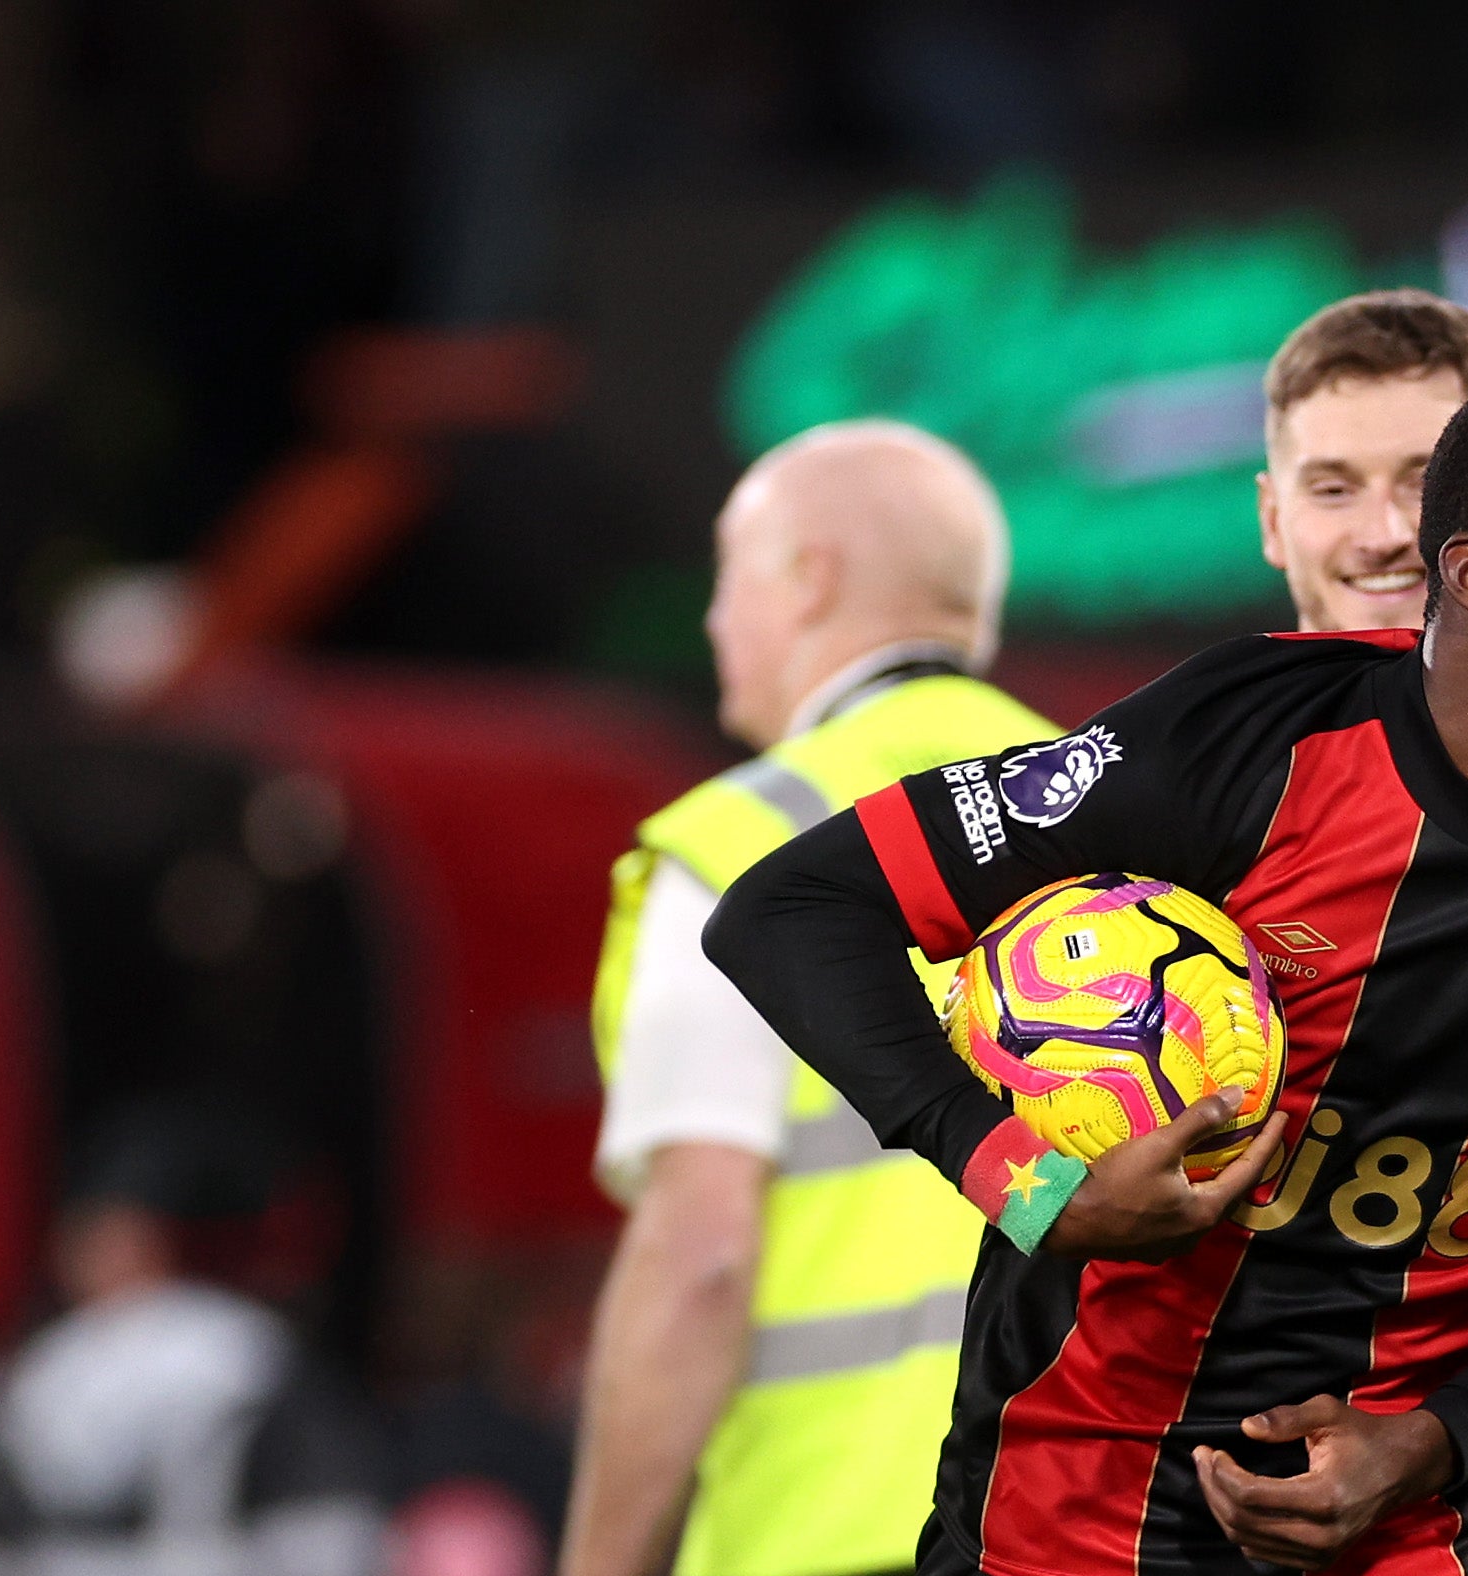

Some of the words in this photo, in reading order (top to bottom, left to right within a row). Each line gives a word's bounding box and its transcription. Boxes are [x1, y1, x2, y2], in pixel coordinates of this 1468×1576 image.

[940, 764, 967, 785] for
[963, 760, 987, 782] No
[950, 783, 994, 865] racism
[971, 780, 1007, 847] room
